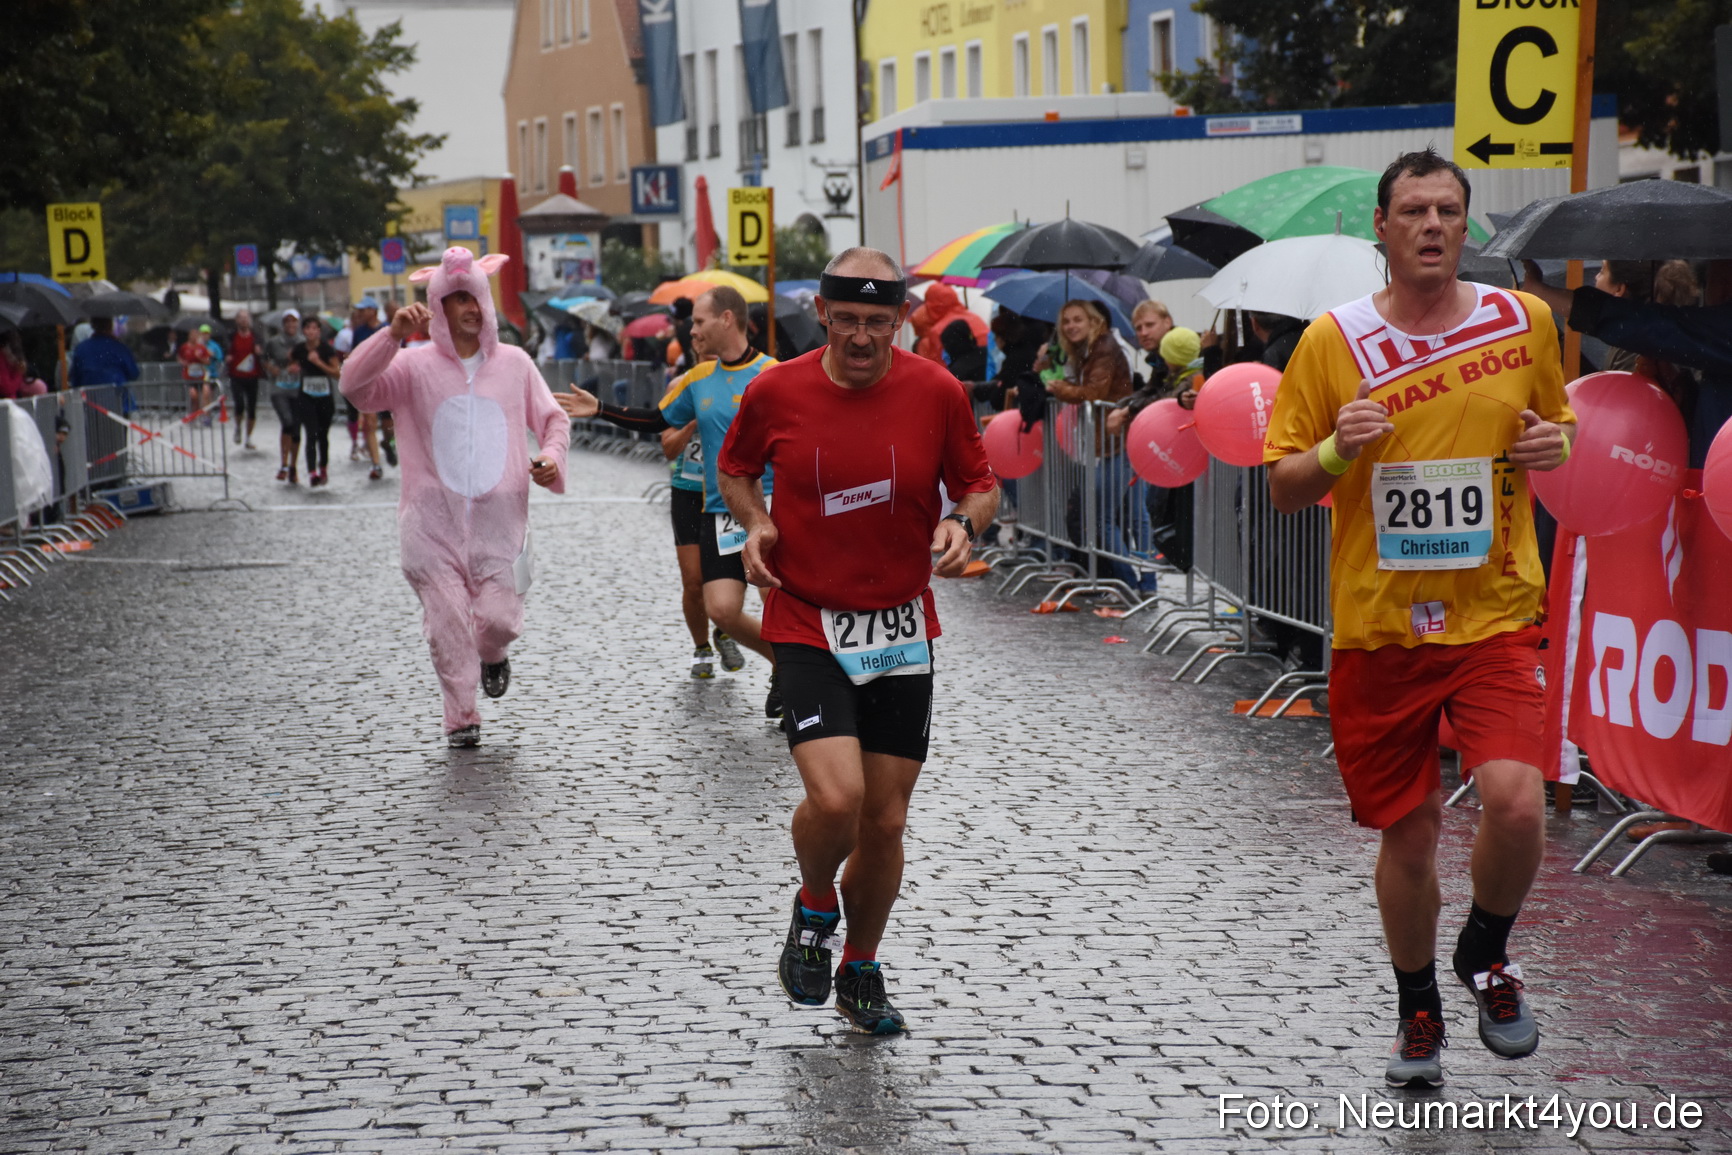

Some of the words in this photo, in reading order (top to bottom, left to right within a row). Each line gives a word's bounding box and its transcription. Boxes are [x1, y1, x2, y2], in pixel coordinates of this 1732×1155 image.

[1490, 25, 1559, 125] C
[732, 189, 768, 204] Block
[54, 206, 95, 222] Block
[740, 211, 762, 247] D
[63, 227, 90, 265] D
[1458, 345, 1533, 385] BÖGL
[1424, 462, 1481, 478] BOCK
[842, 490, 873, 506] DEHN
[1385, 485, 1483, 529] 2819
[1401, 539, 1469, 555] Christian
[836, 602, 917, 648] 2793
[860, 651, 908, 670] Helmut
